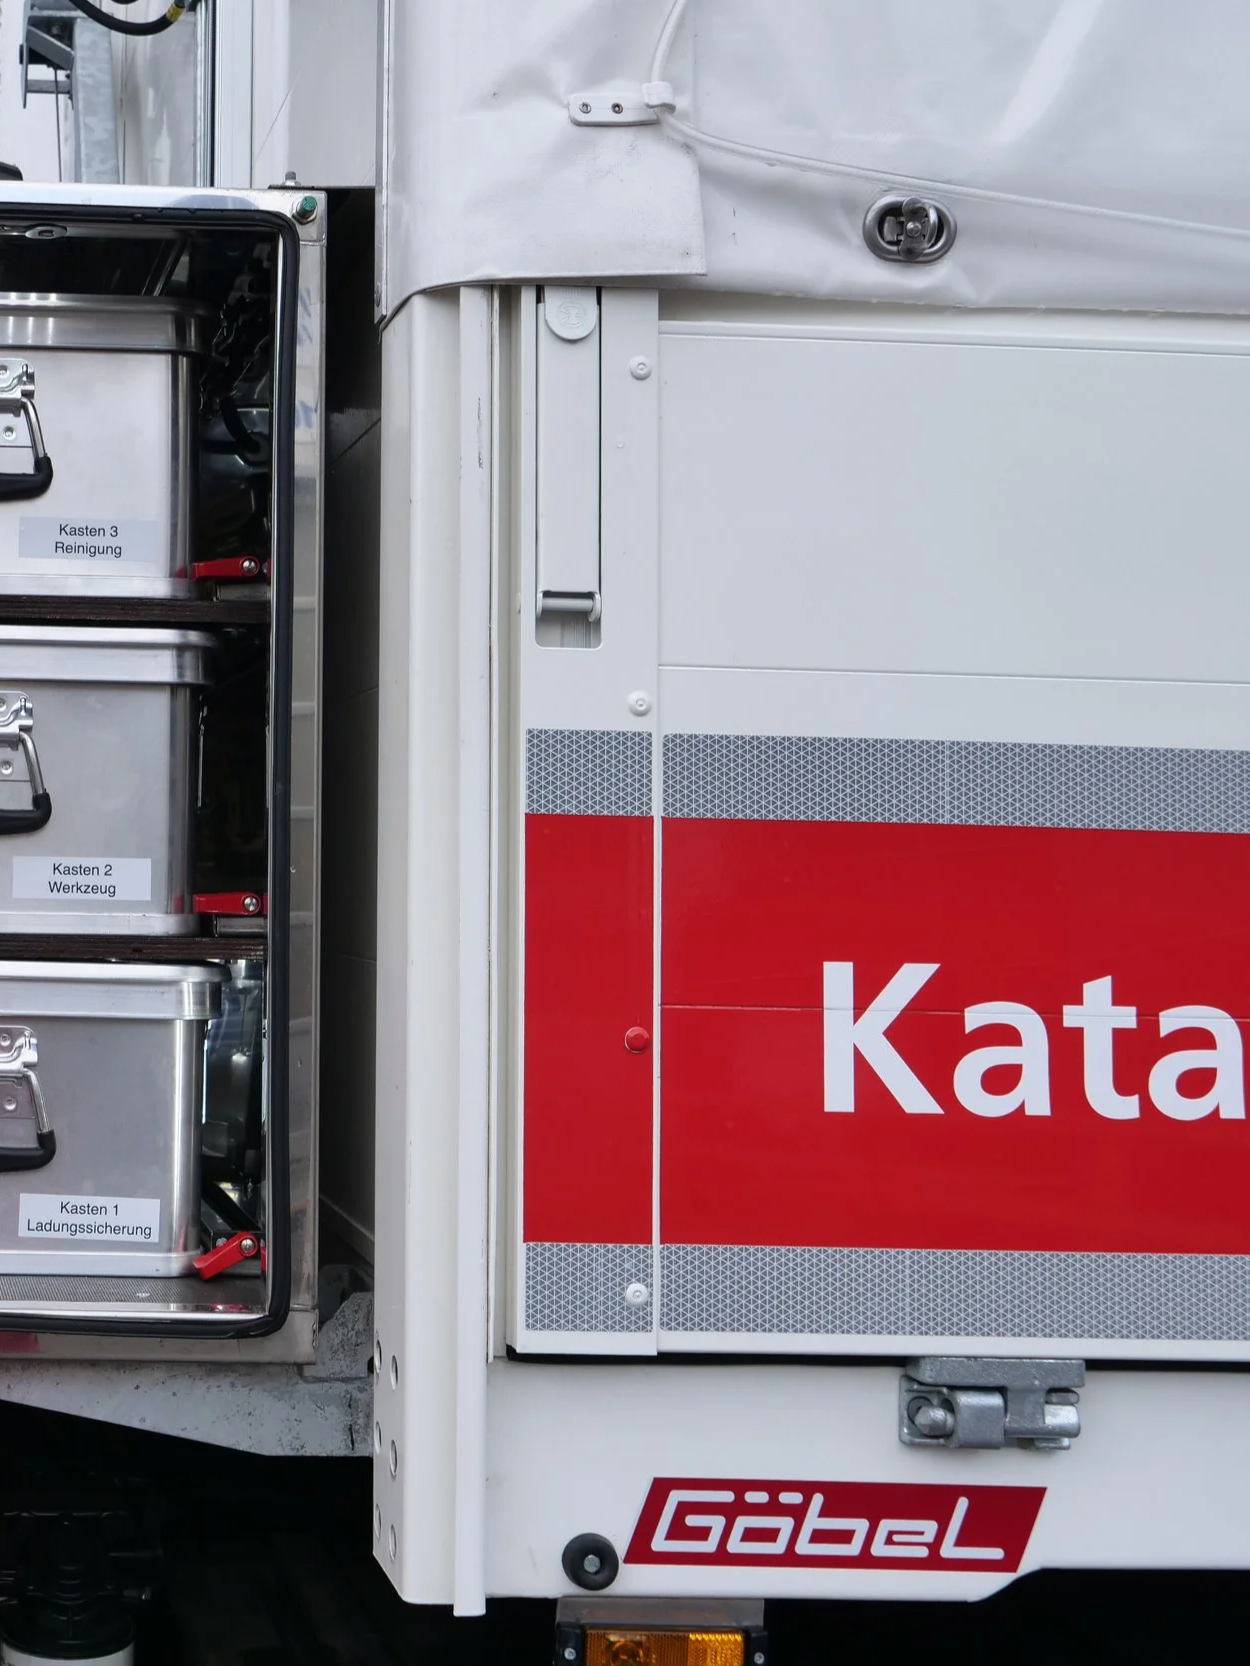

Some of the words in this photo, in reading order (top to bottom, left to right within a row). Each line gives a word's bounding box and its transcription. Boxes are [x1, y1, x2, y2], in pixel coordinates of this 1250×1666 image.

[59, 523, 106, 537] Kasten
[110, 525, 118, 538] 3
[54, 541, 122, 558] Reinigung
[52, 863, 100, 876] Kasten
[104, 864, 113, 877] 2
[48, 881, 117, 898] Werkzeug
[823, 961, 1247, 1121] Kata
[60, 1201, 108, 1215] Kasten
[113, 1204, 119, 1216] 1
[27, 1219, 152, 1239] Ladungssicherung
